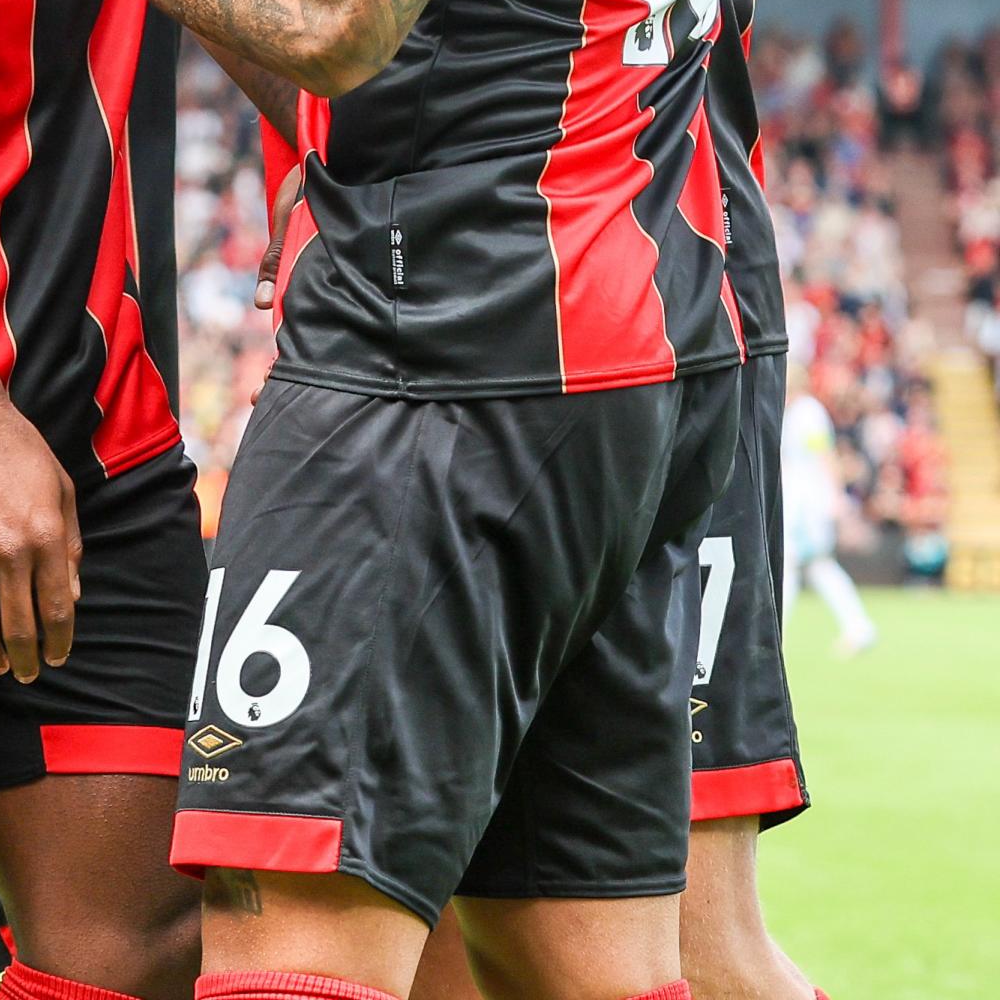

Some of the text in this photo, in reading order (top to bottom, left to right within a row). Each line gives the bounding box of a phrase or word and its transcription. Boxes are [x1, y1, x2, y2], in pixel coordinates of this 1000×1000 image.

[395, 249, 404, 285] official
[188, 567, 312, 728] 16
[188, 764, 230, 783] umbro
